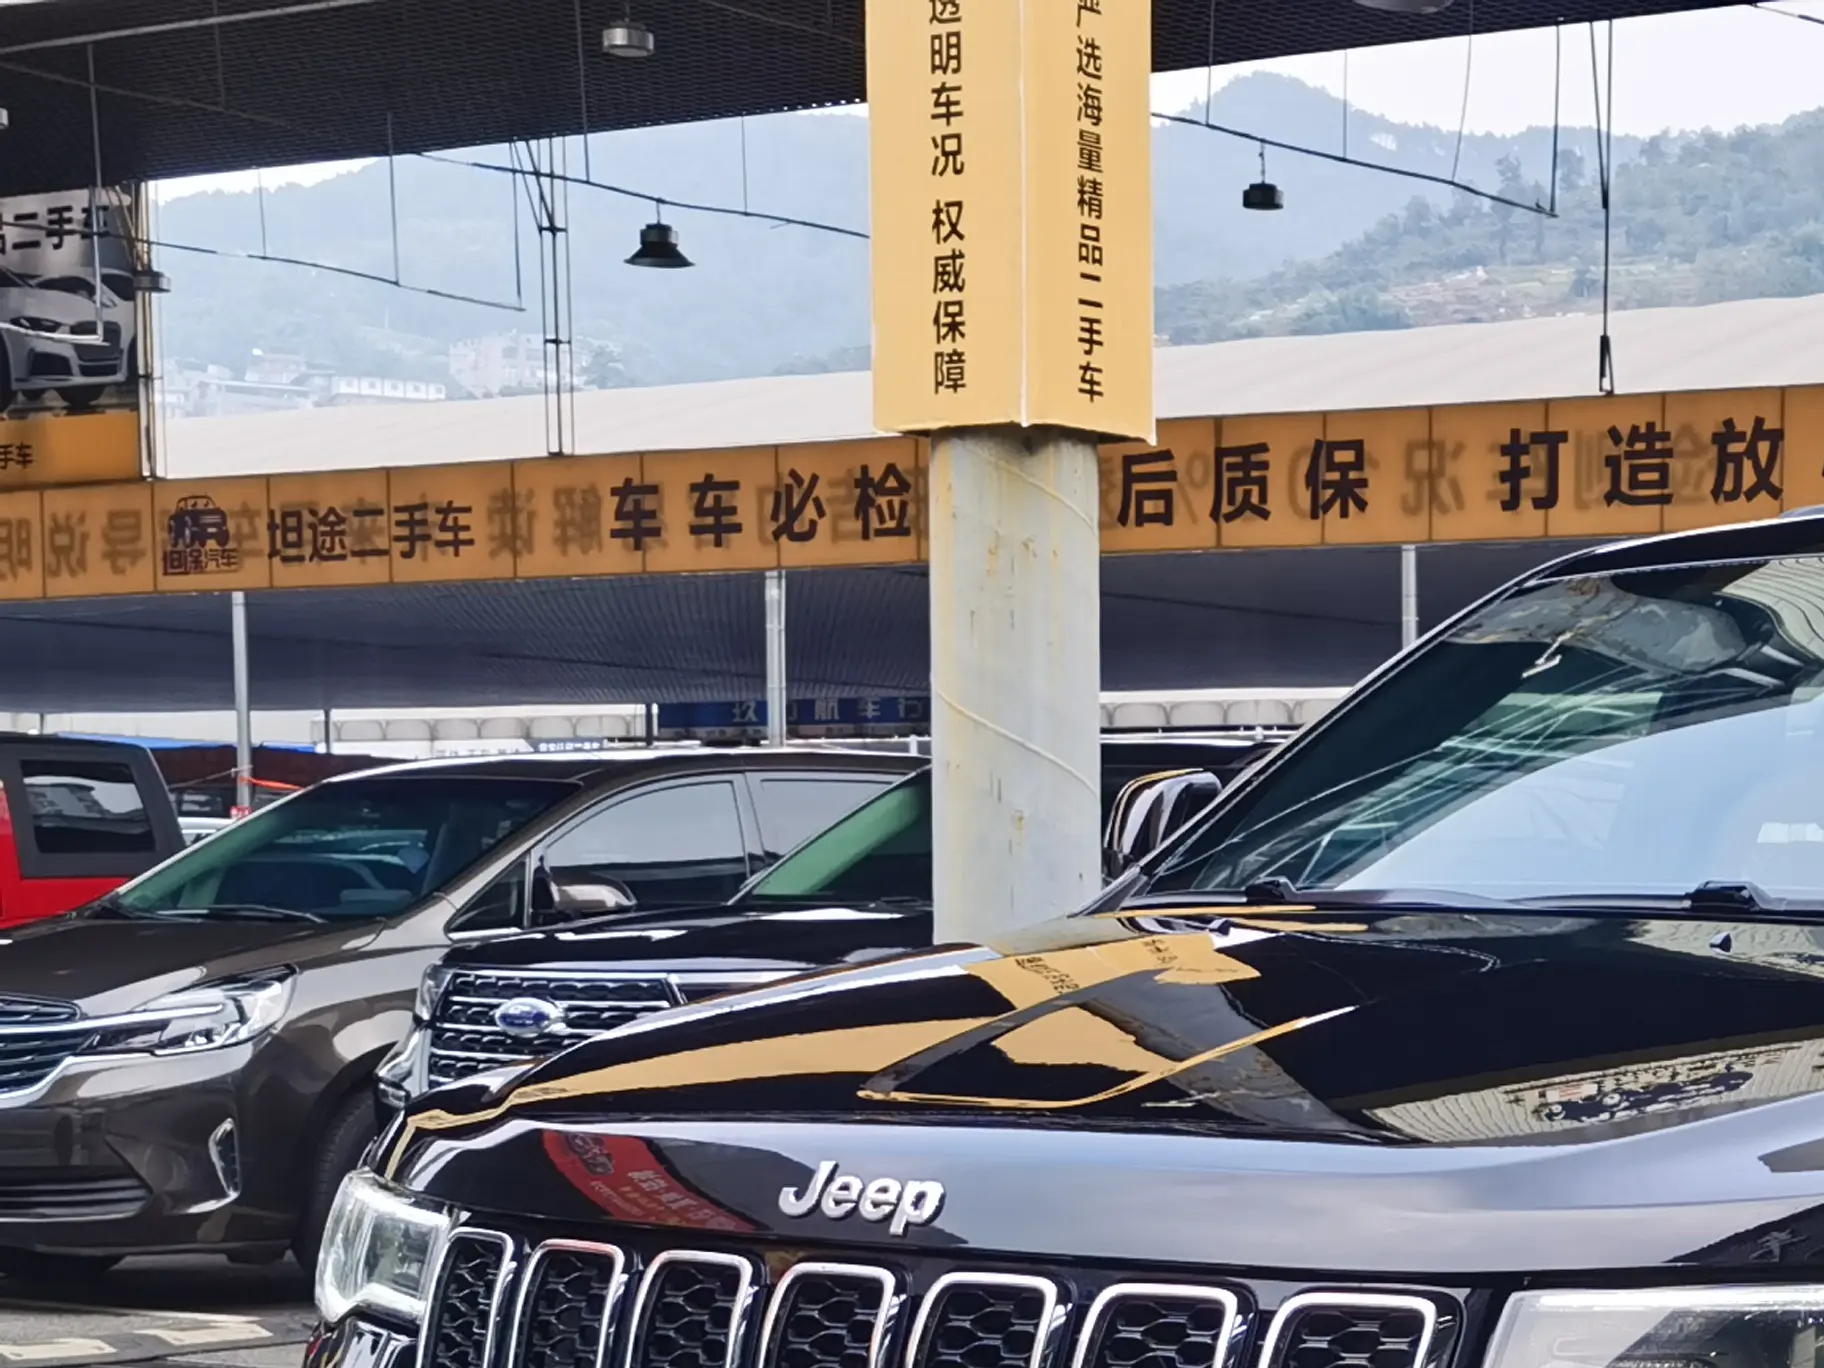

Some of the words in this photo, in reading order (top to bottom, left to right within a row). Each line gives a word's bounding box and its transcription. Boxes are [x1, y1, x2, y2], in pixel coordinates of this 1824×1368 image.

[0, 203, 110, 262] 二手车
[930, 199, 967, 395] 权威保障
[266, 500, 476, 564] 坦途二手车
[608, 461, 913, 552] 车车必检
[1115, 436, 1370, 528] 后质保
[777, 1160, 948, 1236] Jeep
